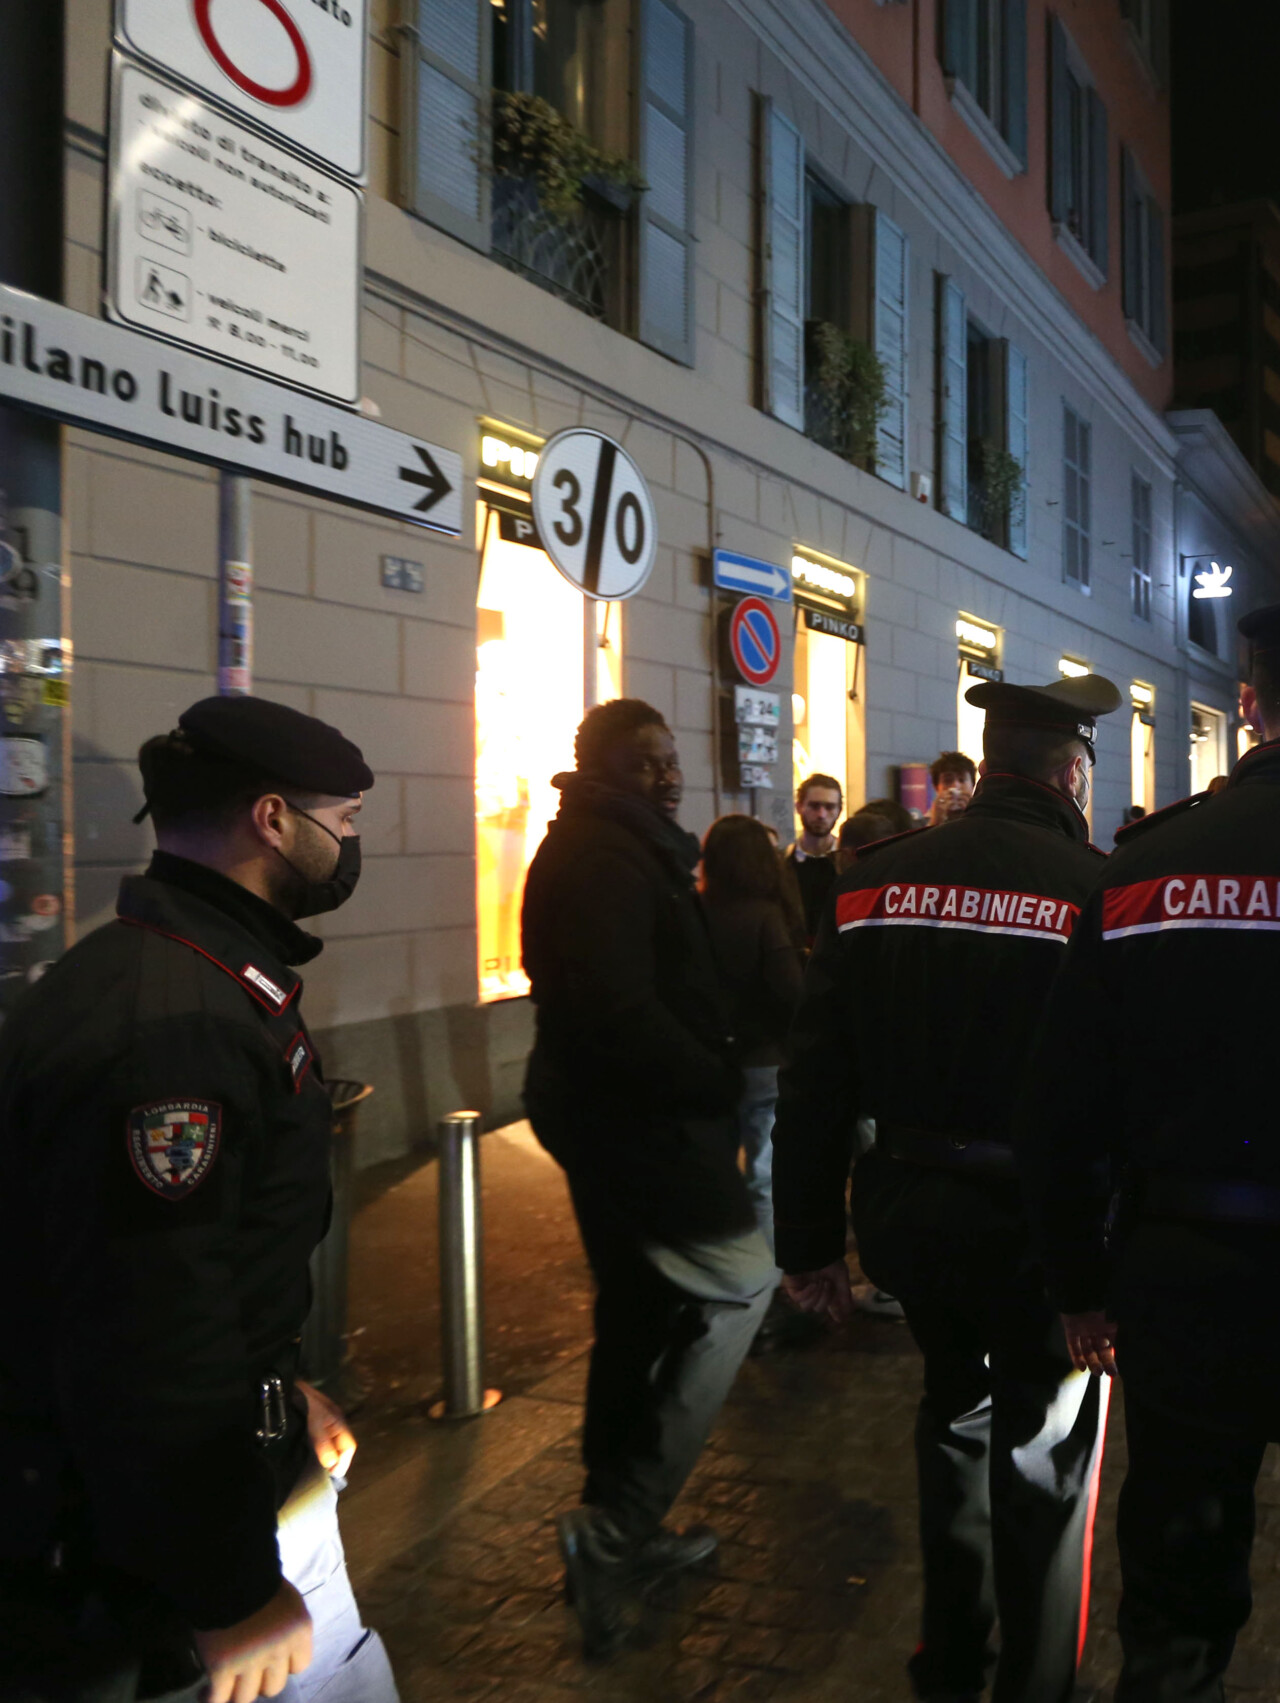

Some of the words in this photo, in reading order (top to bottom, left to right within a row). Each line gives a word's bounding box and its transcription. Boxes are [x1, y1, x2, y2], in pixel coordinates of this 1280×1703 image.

[311, 0, 352, 28] ato
[139, 161, 223, 210] eccetto:
[216, 134, 237, 155] di
[240, 146, 312, 194] transito
[214, 156, 246, 182] non
[250, 176, 331, 225] autorizzati
[208, 226, 287, 273] biciclette
[208, 292, 264, 324] veicoli
[267, 317, 311, 342] merci
[228, 322, 266, 348] 8.00
[157, 369, 267, 446] luiss
[281, 413, 350, 472] hub
[811, 613, 858, 640] PINKO
[884, 884, 1069, 931] CARABINIERI
[144, 1102, 209, 1117] LOMBARDIA
[187, 1122, 217, 1185] CARABINIERI
